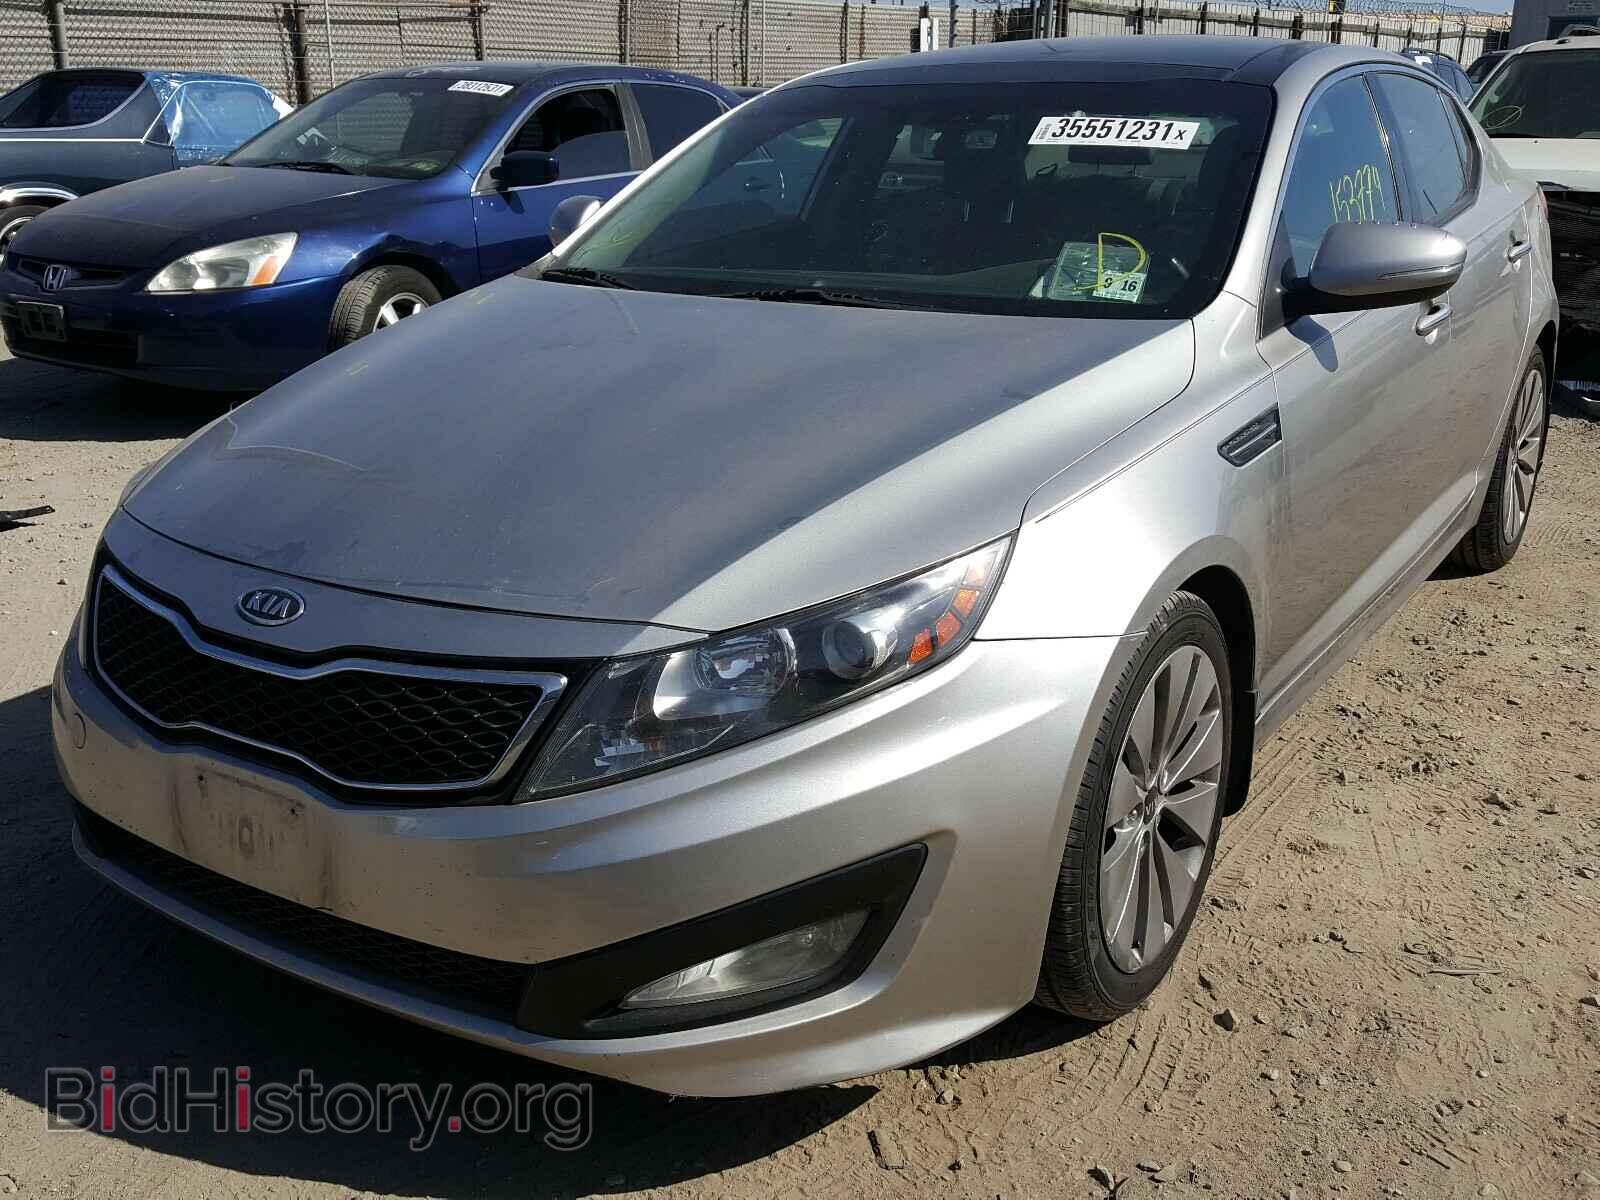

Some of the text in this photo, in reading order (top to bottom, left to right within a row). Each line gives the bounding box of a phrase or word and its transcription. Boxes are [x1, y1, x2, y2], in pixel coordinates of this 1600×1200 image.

[1051, 118, 1174, 142] 35551231
[1121, 280, 1137, 292] 16
[245, 590, 291, 618] KIA
